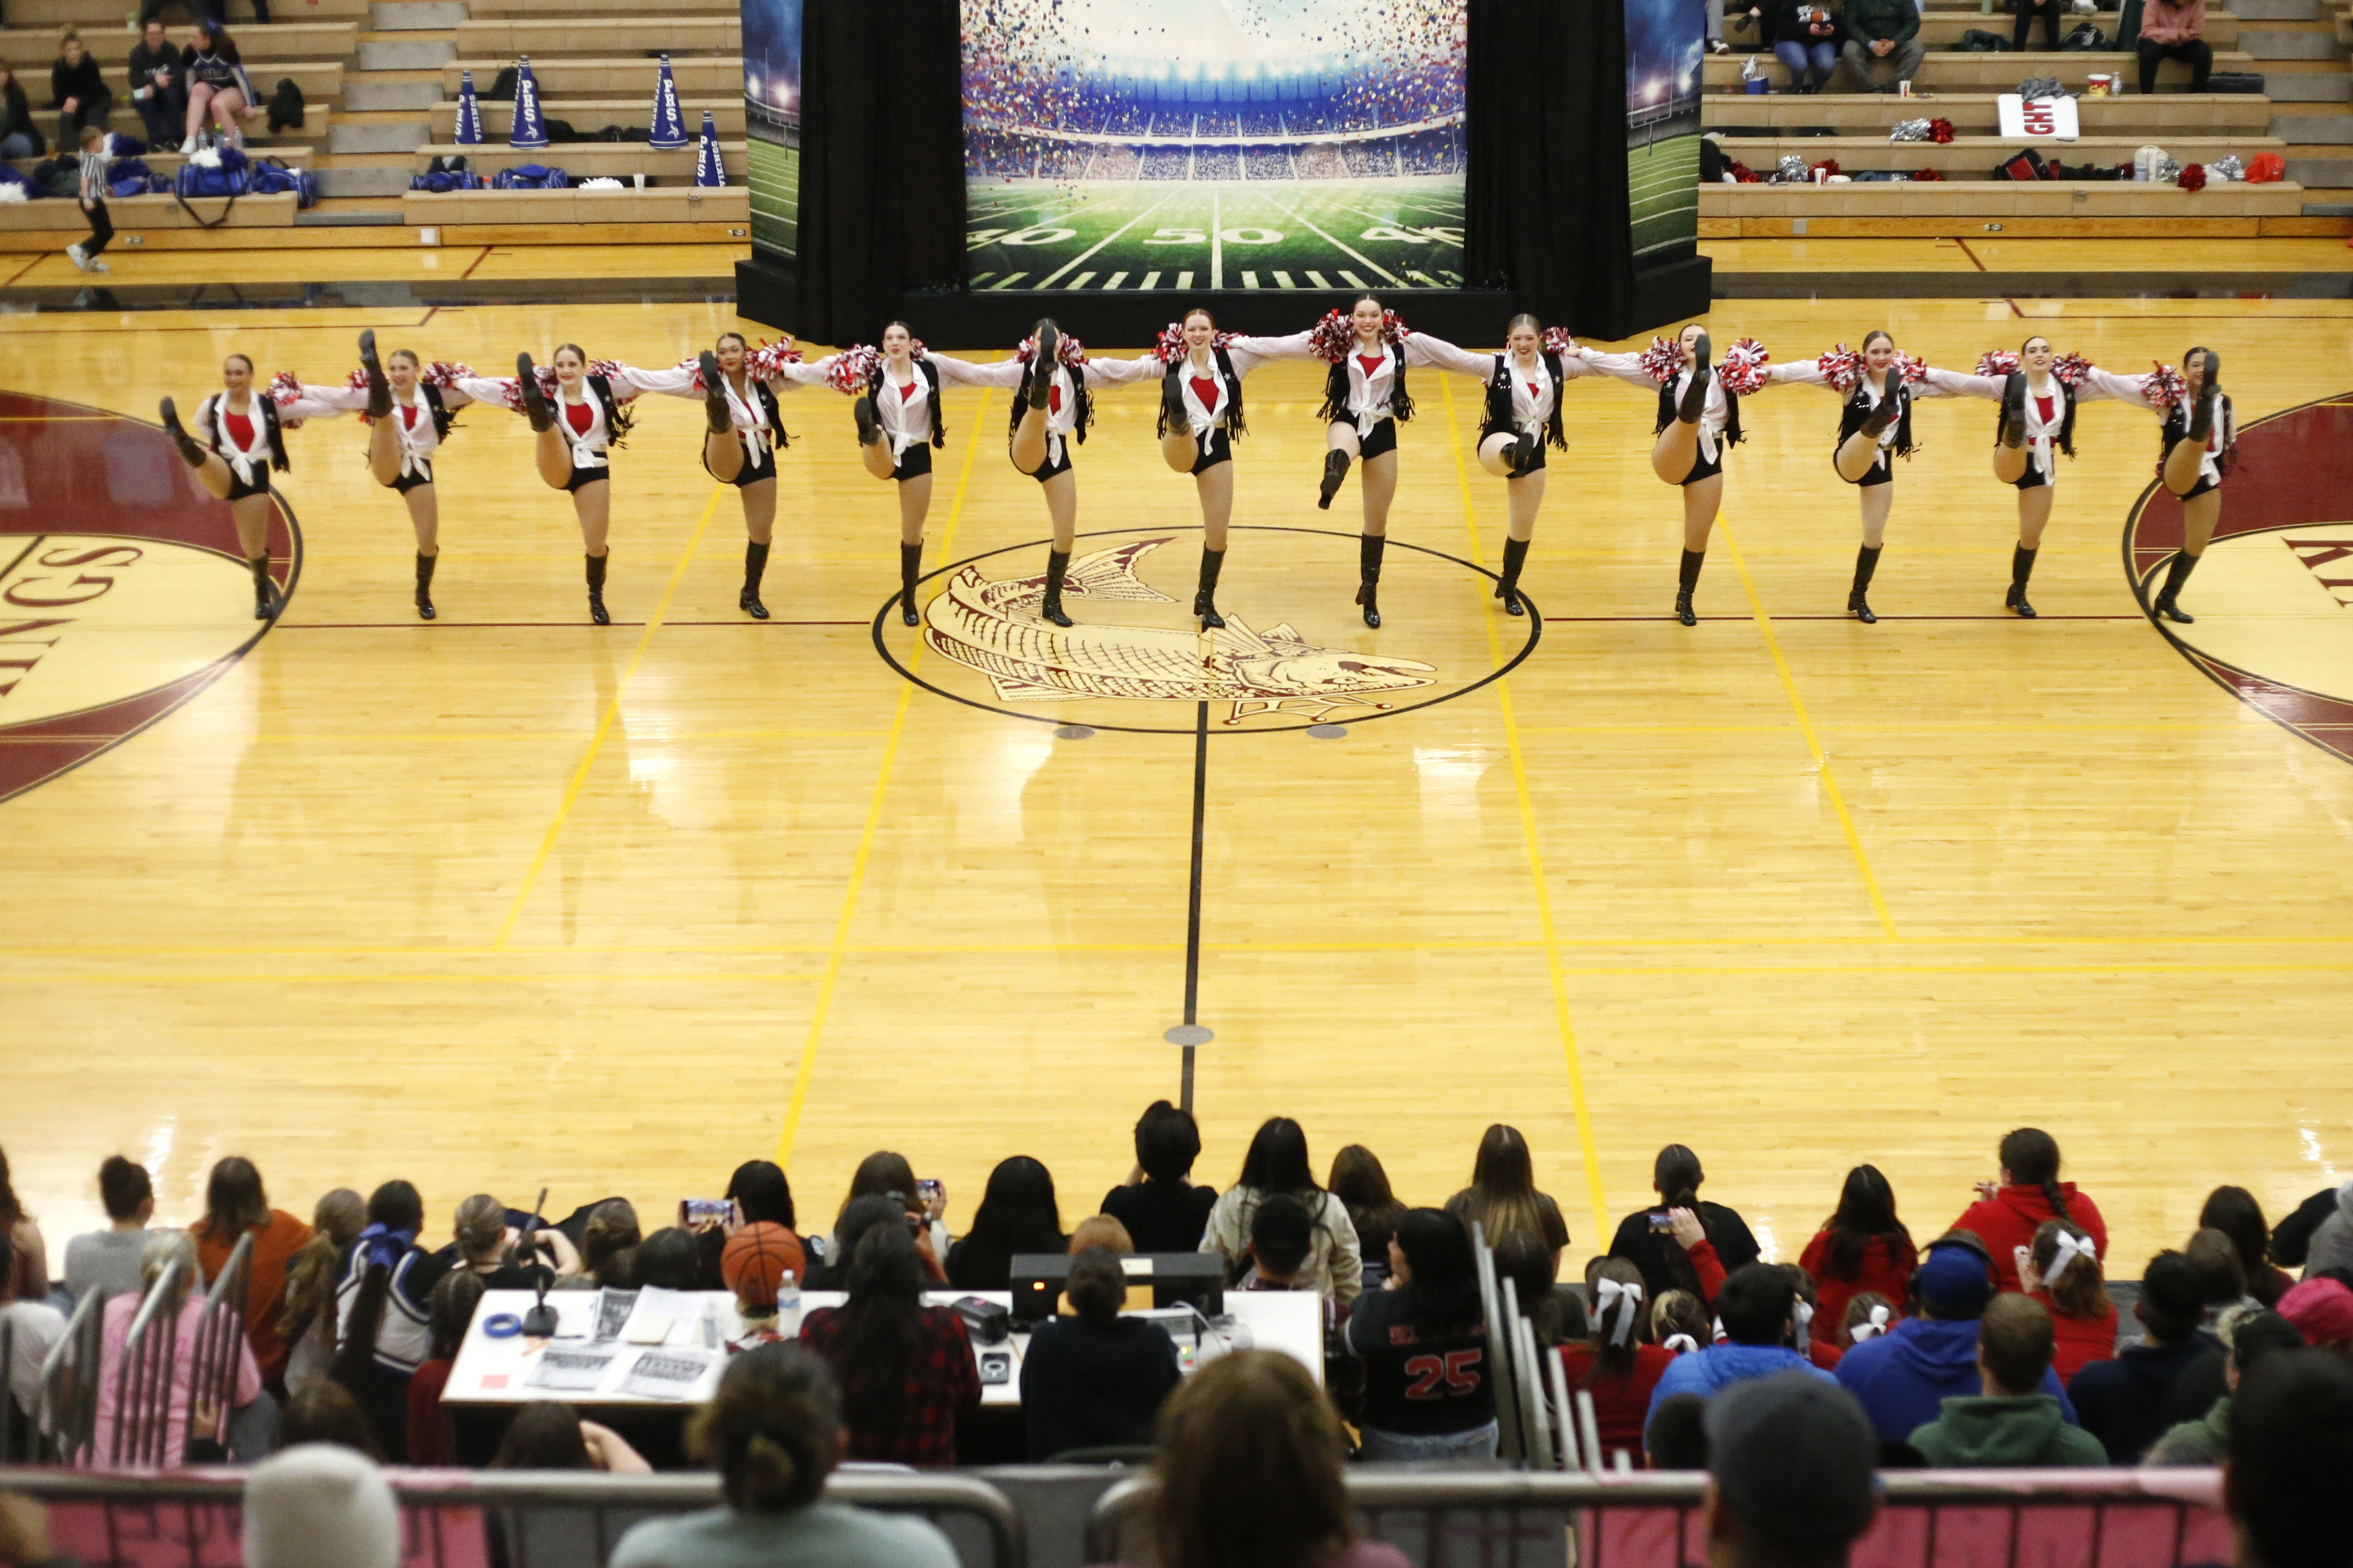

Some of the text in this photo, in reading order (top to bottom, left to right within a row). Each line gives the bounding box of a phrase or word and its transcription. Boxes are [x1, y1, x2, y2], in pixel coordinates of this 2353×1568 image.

[454, 95, 465, 135] PHS
[469, 95, 482, 142] VIKINGS
[522, 80, 535, 122] PHS
[663, 79, 677, 121] PHS
[697, 135, 708, 177] PHS
[711, 140, 726, 187] VIKINGS
[1143, 228, 1284, 244] 50
[1405, 1347, 1482, 1399] 25
